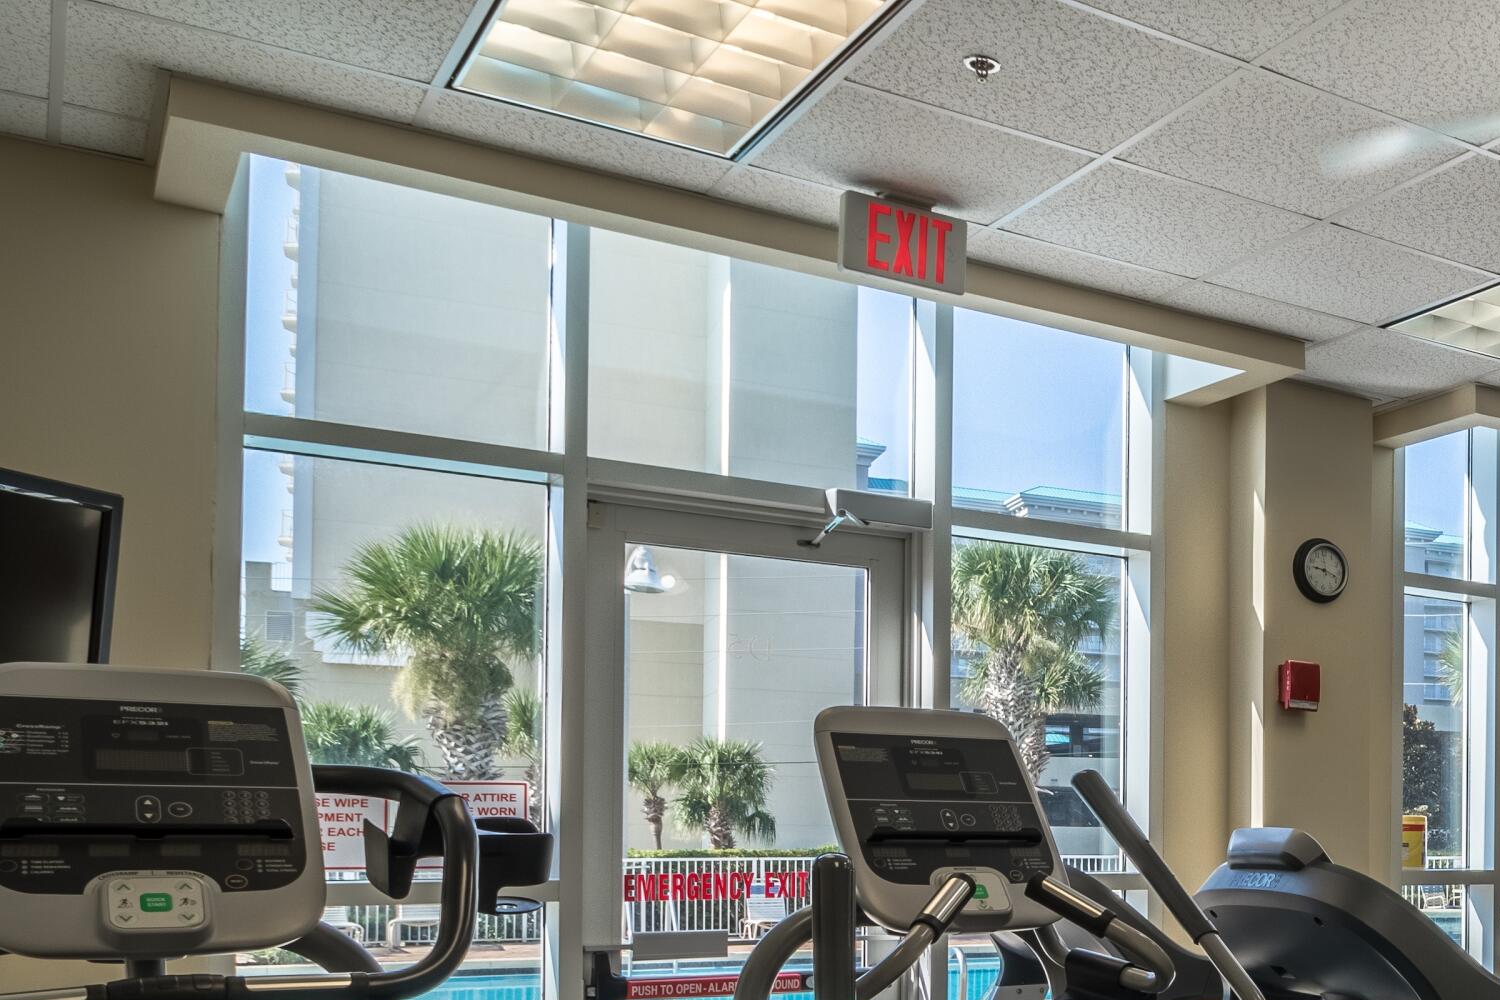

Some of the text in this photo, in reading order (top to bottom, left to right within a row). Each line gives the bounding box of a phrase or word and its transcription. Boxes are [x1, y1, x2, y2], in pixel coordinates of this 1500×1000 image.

[866, 202, 953, 285] EXIT
[473, 793, 517, 802] ATTIRE
[314, 798, 369, 808] SE WIPE
[477, 807, 517, 816] WORN
[316, 813, 363, 822] PMENT
[320, 841, 336, 851] SE
[624, 871, 810, 902] EMERGENCY EXIT
[631, 985, 658, 996] PUSH
[660, 984, 674, 995] TO
[708, 981, 738, 993] ALAR
[773, 978, 800, 990] OUND
